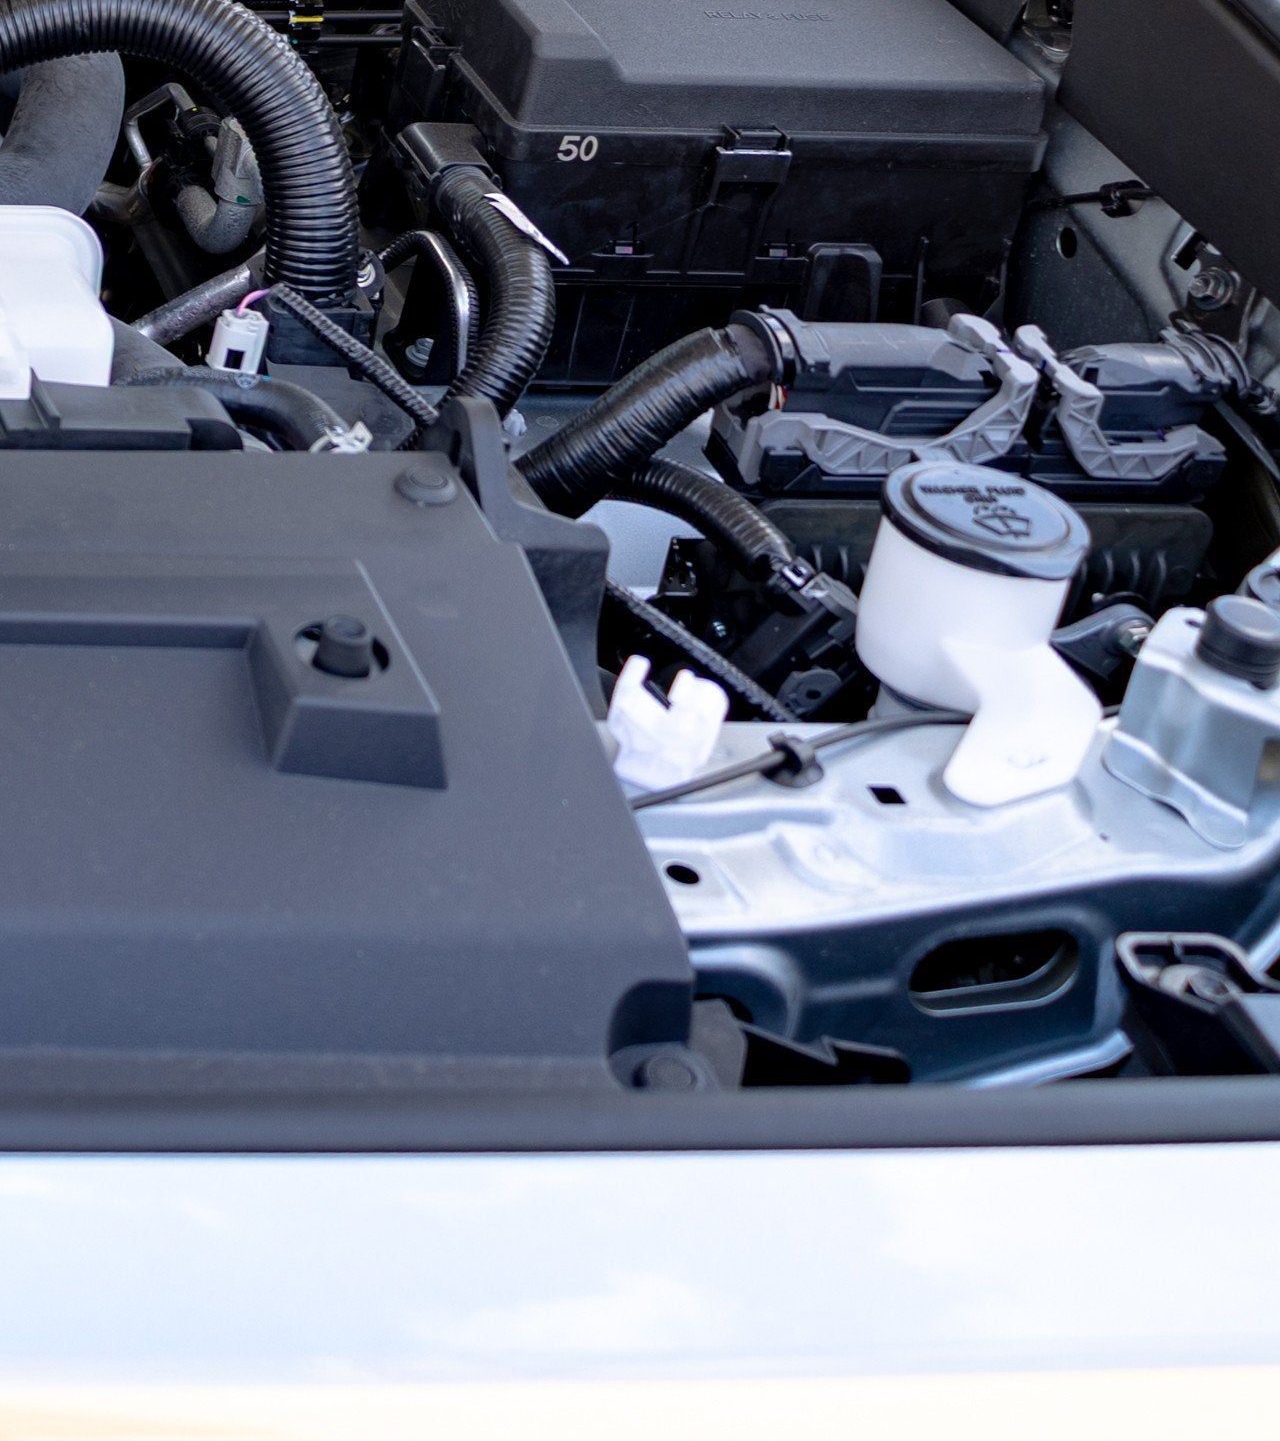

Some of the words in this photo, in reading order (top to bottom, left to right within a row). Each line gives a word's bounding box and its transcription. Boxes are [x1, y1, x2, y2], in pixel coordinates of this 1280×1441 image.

[703, 10, 762, 20] RELAY
[781, 13, 833, 22] FUSE
[557, 135, 599, 162] 50
